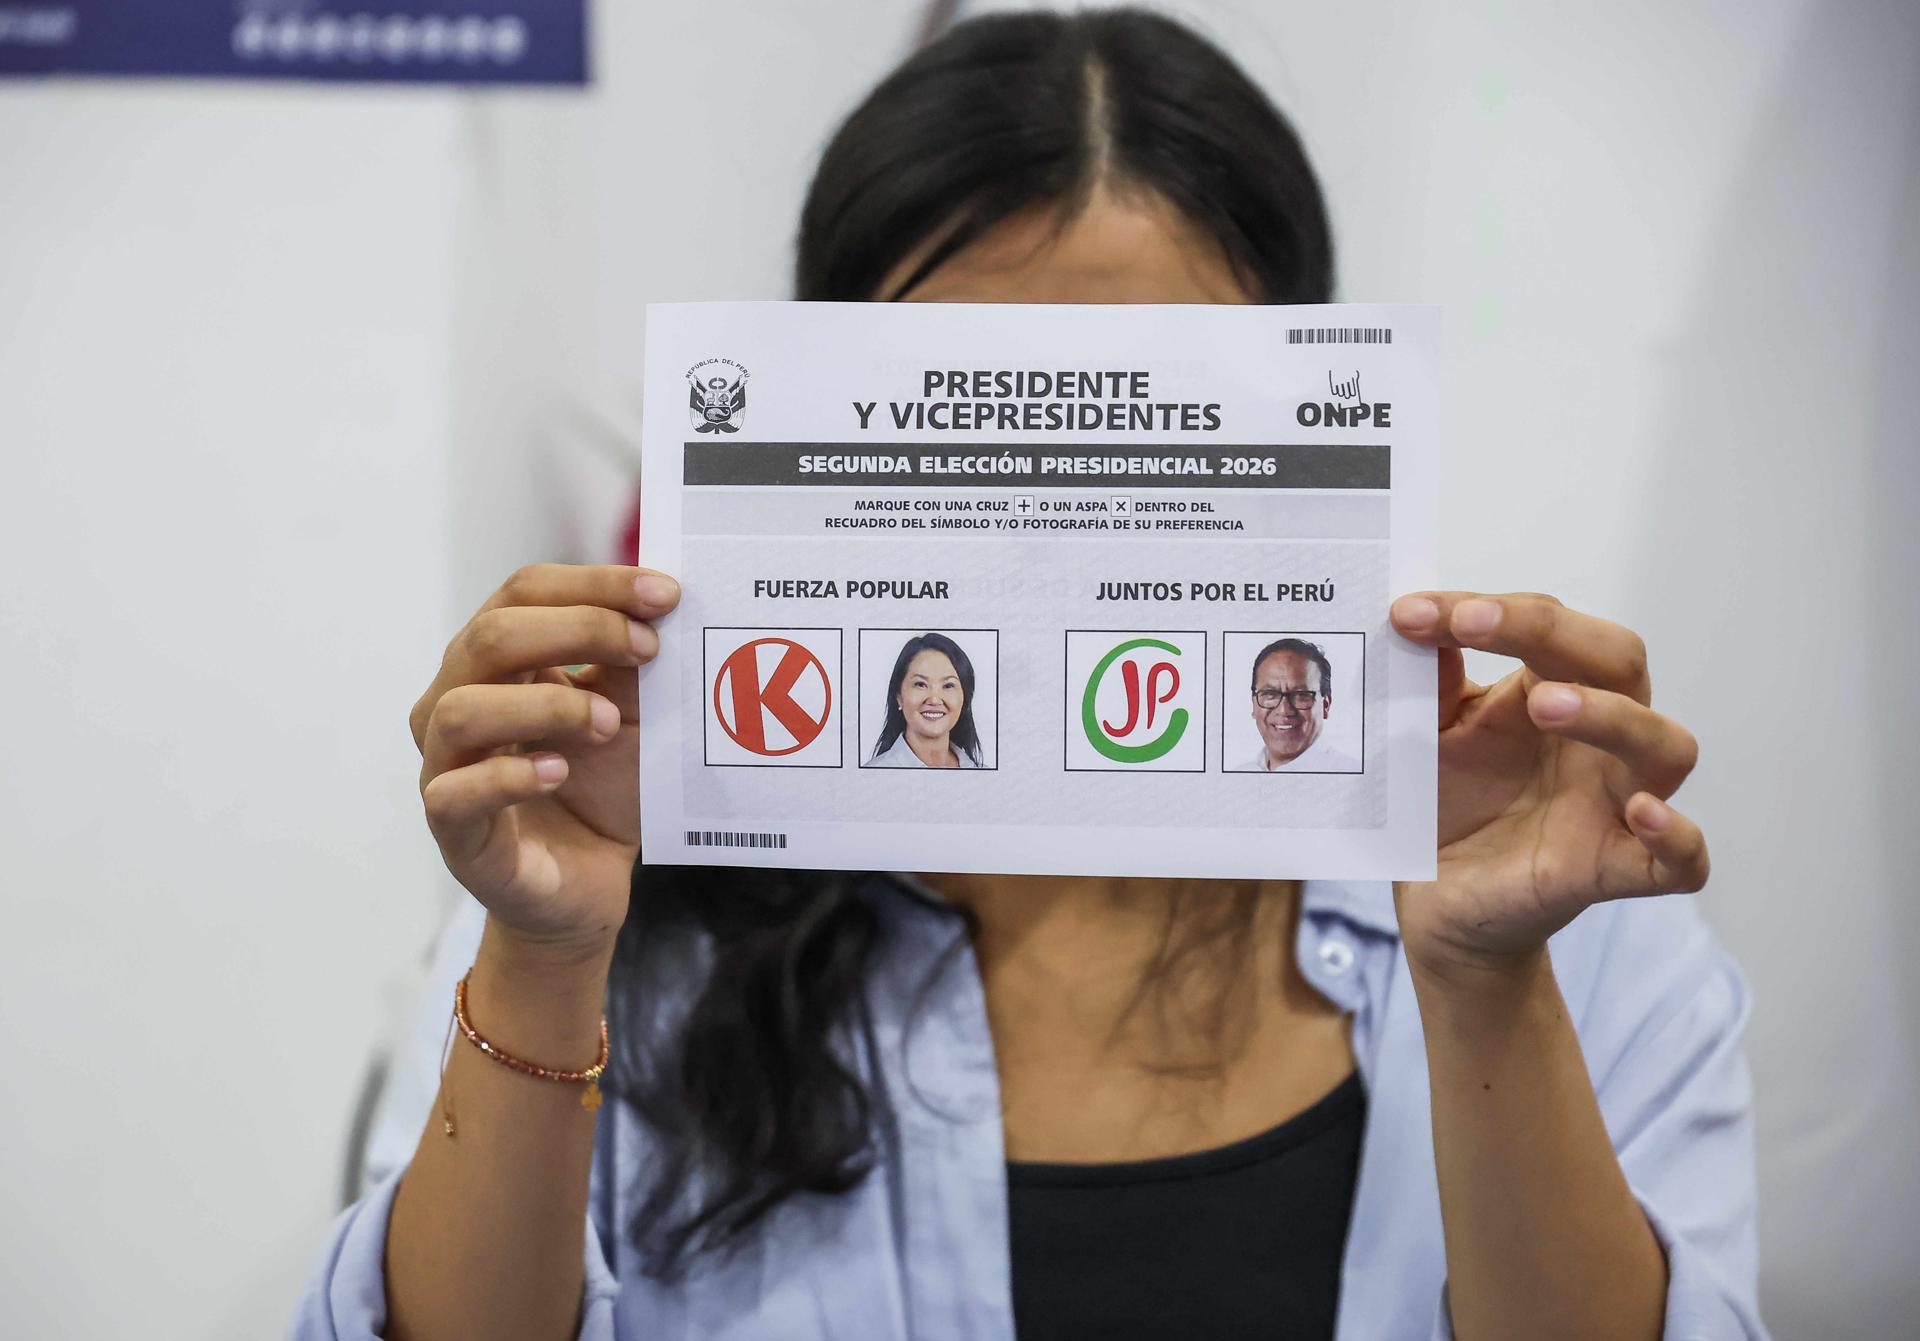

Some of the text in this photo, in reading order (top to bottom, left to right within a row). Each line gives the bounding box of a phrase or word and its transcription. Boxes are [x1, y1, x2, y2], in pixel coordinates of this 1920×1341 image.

[721, 358, 735, 367] DEL
[924, 370, 1150, 399] PRESIDENTE
[853, 402, 1221, 431] Y VICEPRESIDENTES
[1296, 402, 1392, 428] ONPE
[798, 450, 1277, 476] SEGUNDA ELECCIÓN PRESIDENCIAL 2026
[854, 500, 1215, 513] MARQUE CON UNA CRUZ O UN ASPA DENTRO DEL
[824, 515, 1245, 531] RECUADRO DEL SÍMBOLO Y/O FOTOGRAFÍA DE SU PREFERENCIA
[754, 579, 840, 599] FUERZA
[846, 580, 949, 600] POPULAR
[1096, 582, 1183, 602] JUNTOS
[1190, 583, 1236, 602] POR
[1243, 583, 1270, 602] EL
[1276, 577, 1335, 602] PERÚ
